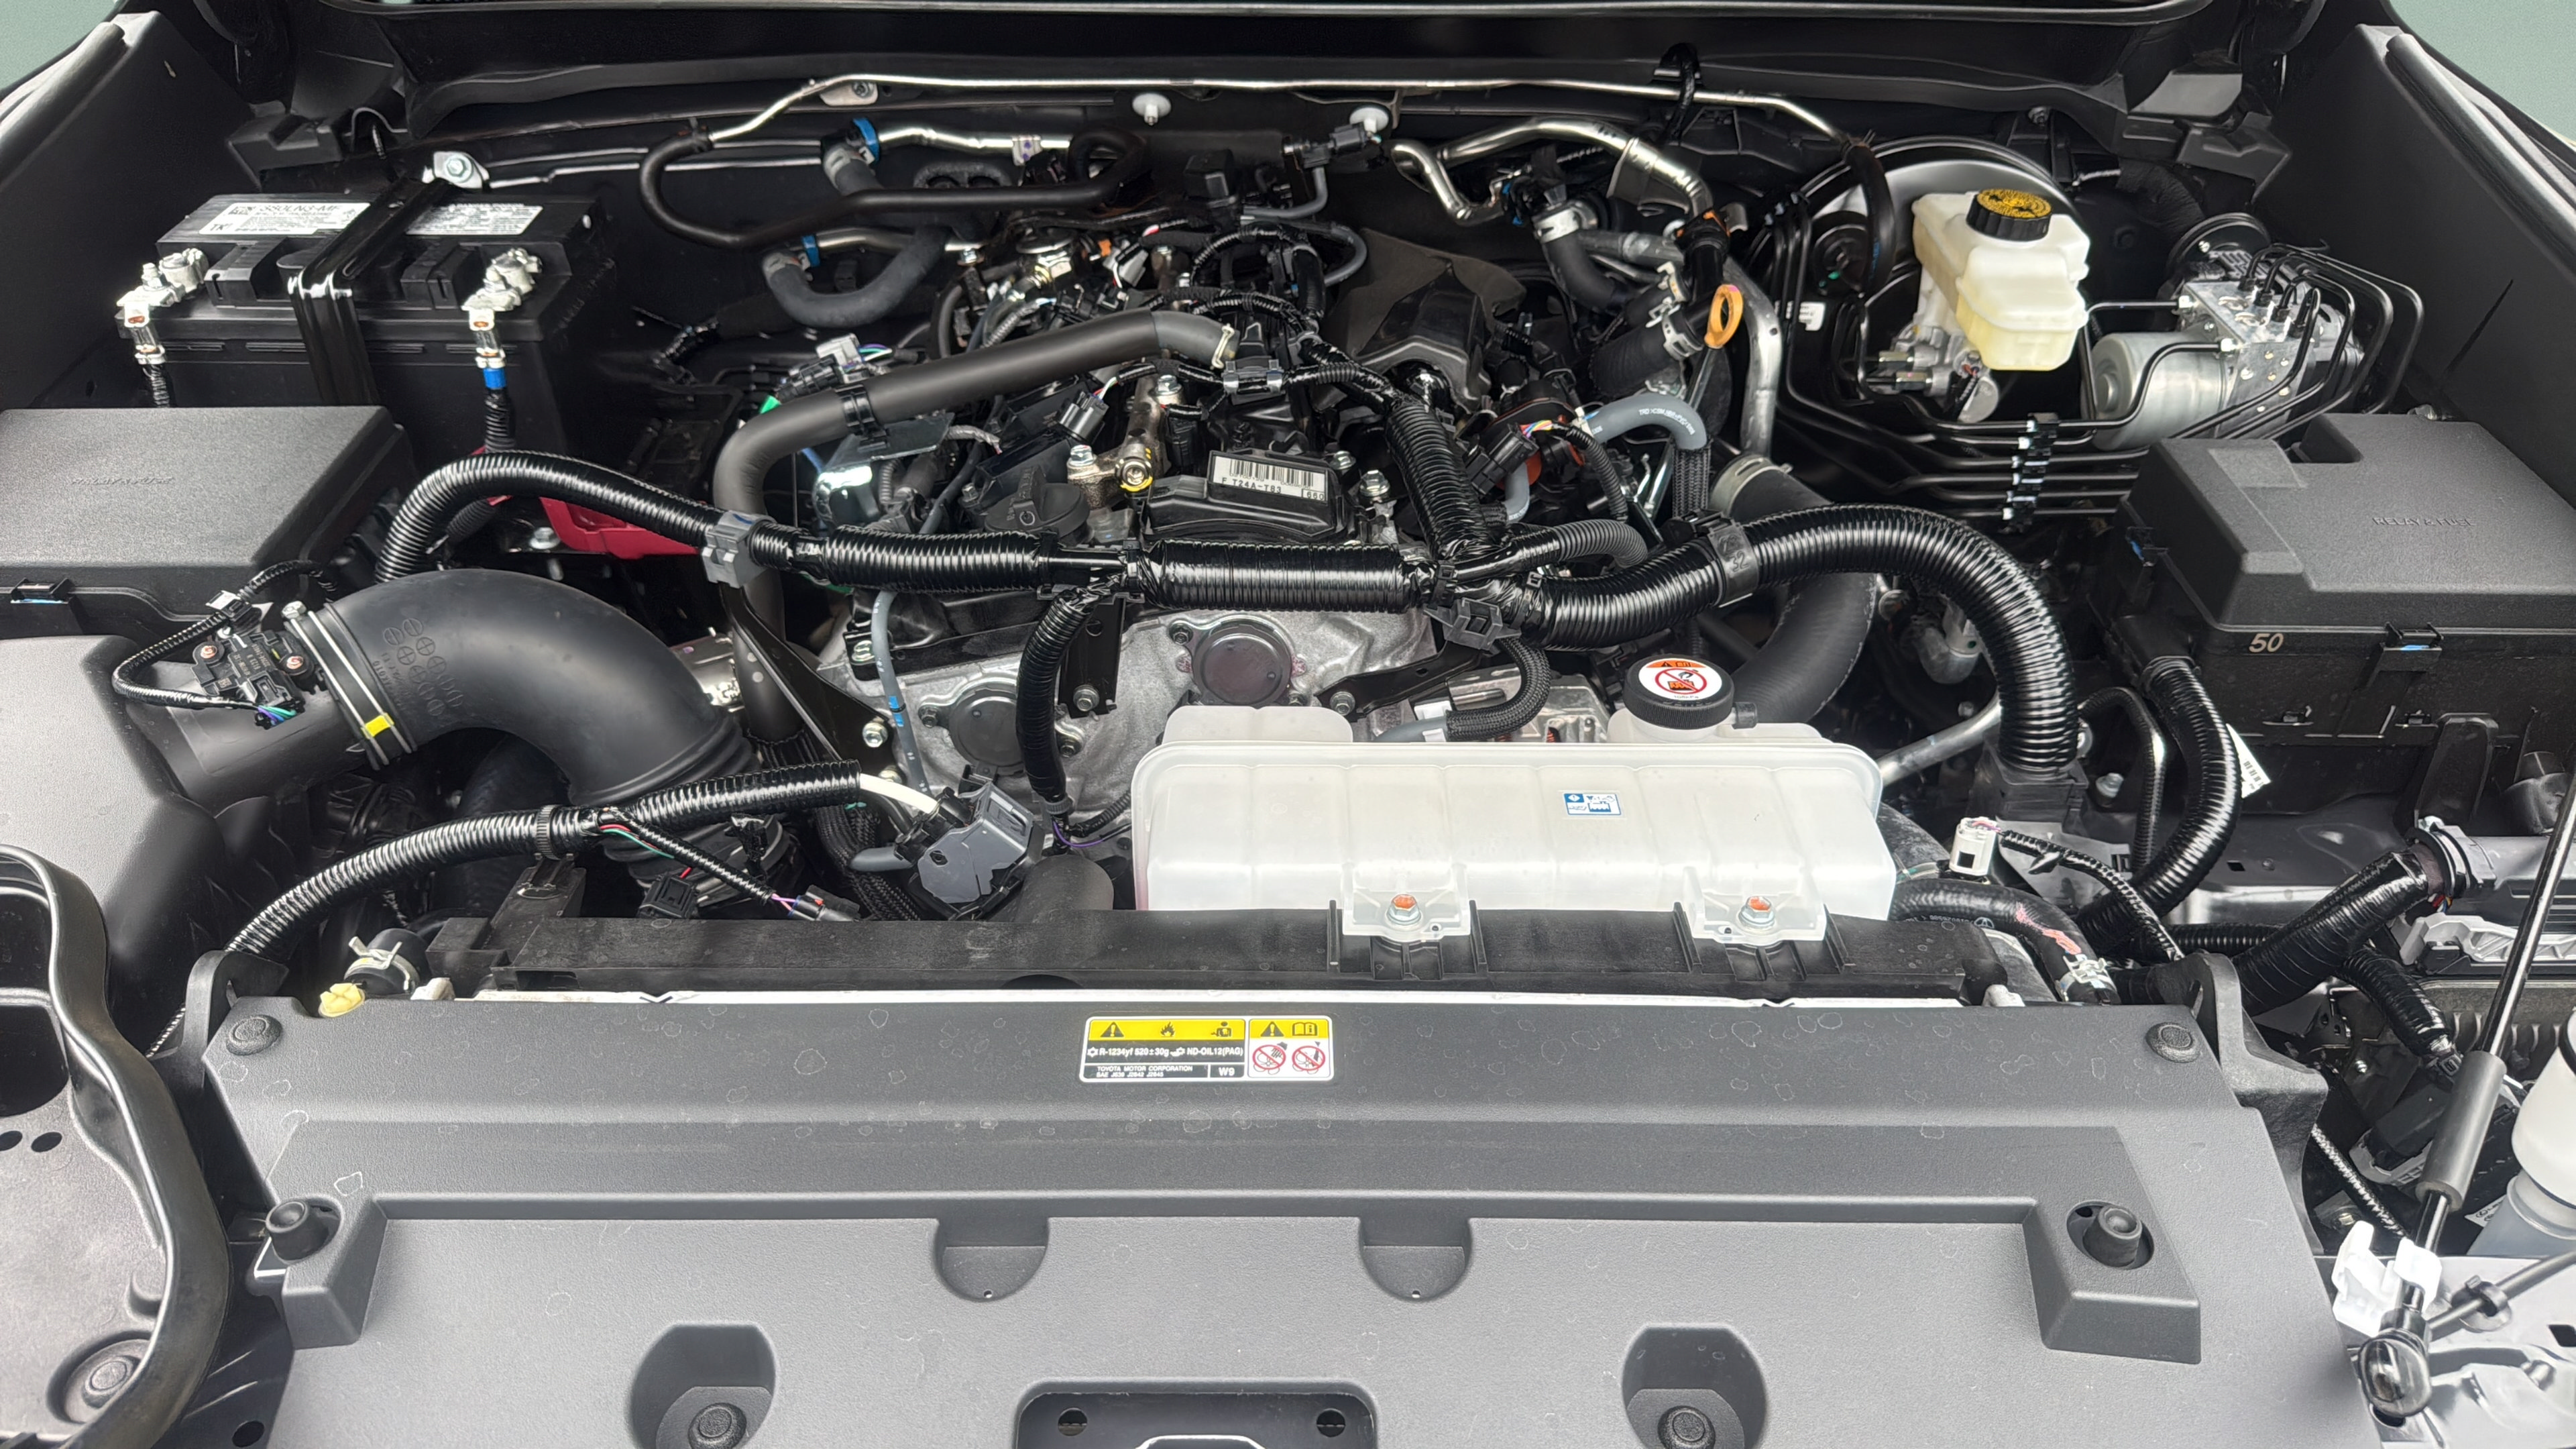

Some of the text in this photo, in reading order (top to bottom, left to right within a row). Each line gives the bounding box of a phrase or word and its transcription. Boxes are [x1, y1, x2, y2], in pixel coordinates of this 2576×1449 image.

[1231, 479, 1282, 494] T24A-T83
[1306, 492, 1325, 501] 660
[2372, 517, 2477, 527] RELAY & FUSE
[2249, 633, 2284, 653] 50
[1099, 1047, 1133, 1057] R-1234yf
[1186, 1047, 1243, 1057] ND-OIL12(PAG)
[1218, 1067, 1235, 1077] W9
